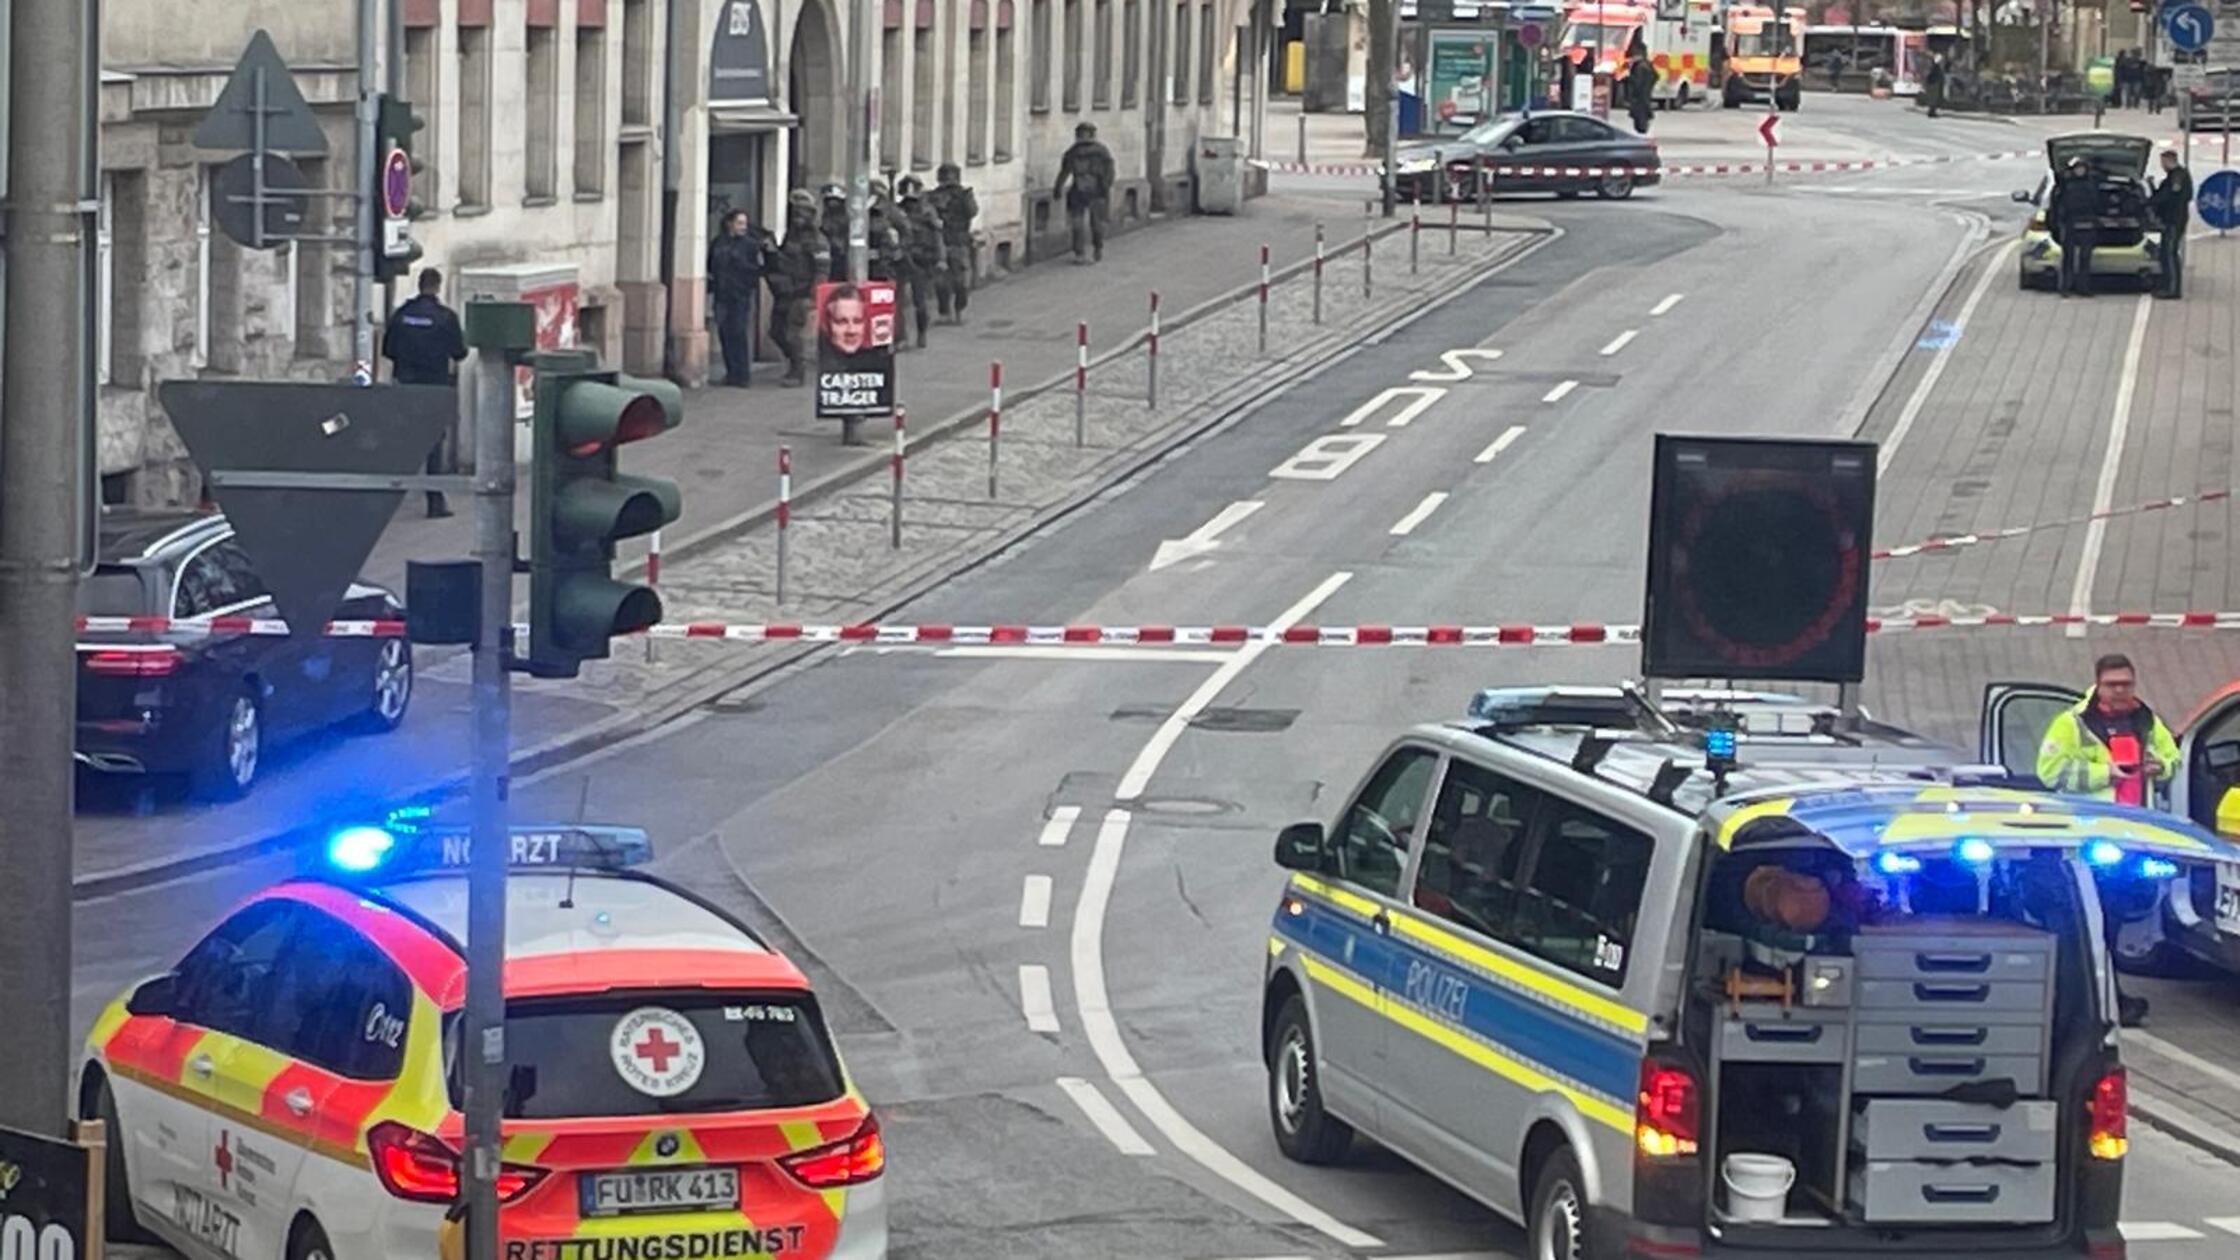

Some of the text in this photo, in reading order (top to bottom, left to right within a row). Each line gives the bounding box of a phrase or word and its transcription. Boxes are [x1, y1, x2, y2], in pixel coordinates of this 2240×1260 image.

[820, 372, 884, 389] CARSTEN
[821, 388, 878, 406] TRÄGER
[1268, 349, 1504, 480] BUS
[1406, 959, 1469, 1022] POLIZEI
[599, 1172, 735, 1203] FU RK 413
[504, 1225, 806, 1260] RETTUNGSDIENST
